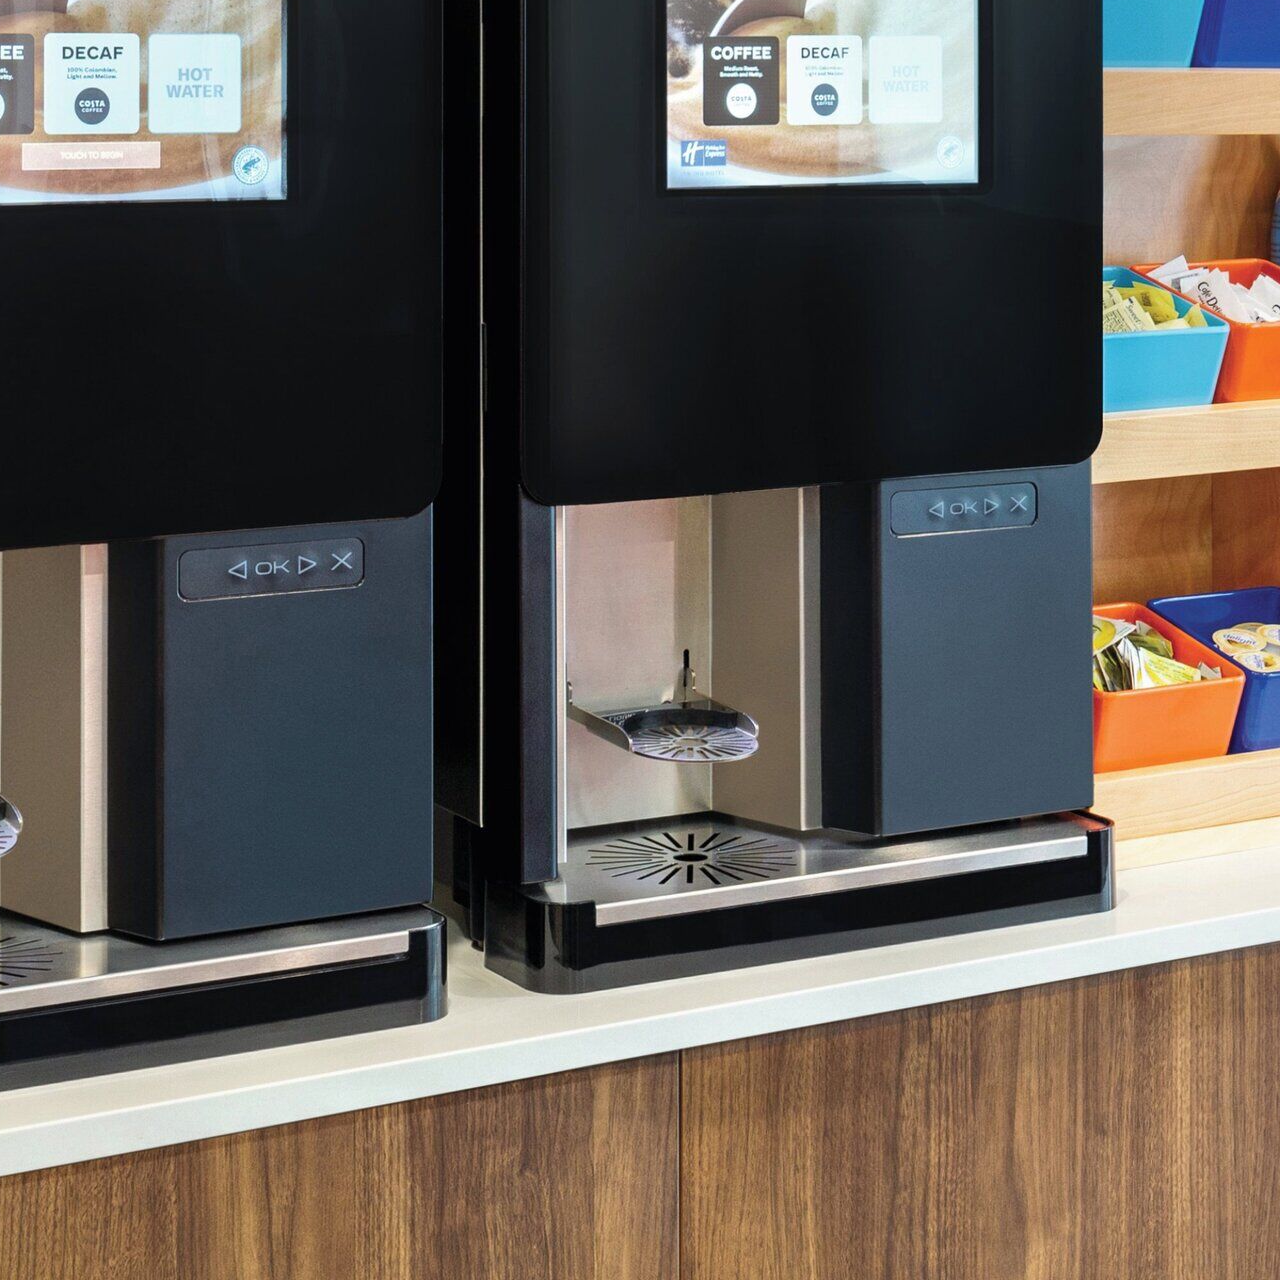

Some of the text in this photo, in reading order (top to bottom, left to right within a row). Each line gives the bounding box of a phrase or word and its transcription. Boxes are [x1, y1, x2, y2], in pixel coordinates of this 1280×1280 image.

[62, 46, 124, 60] DECAF
[711, 46, 772, 60] COFFEE
[801, 47, 850, 59] DECAF
[177, 67, 211, 82] HOT
[892, 65, 920, 78] HOT
[166, 84, 224, 99] WATER
[883, 79, 929, 92] WATER
[79, 100, 106, 108] COSTA
[949, 501, 978, 515] OK
[255, 559, 290, 576] OK
